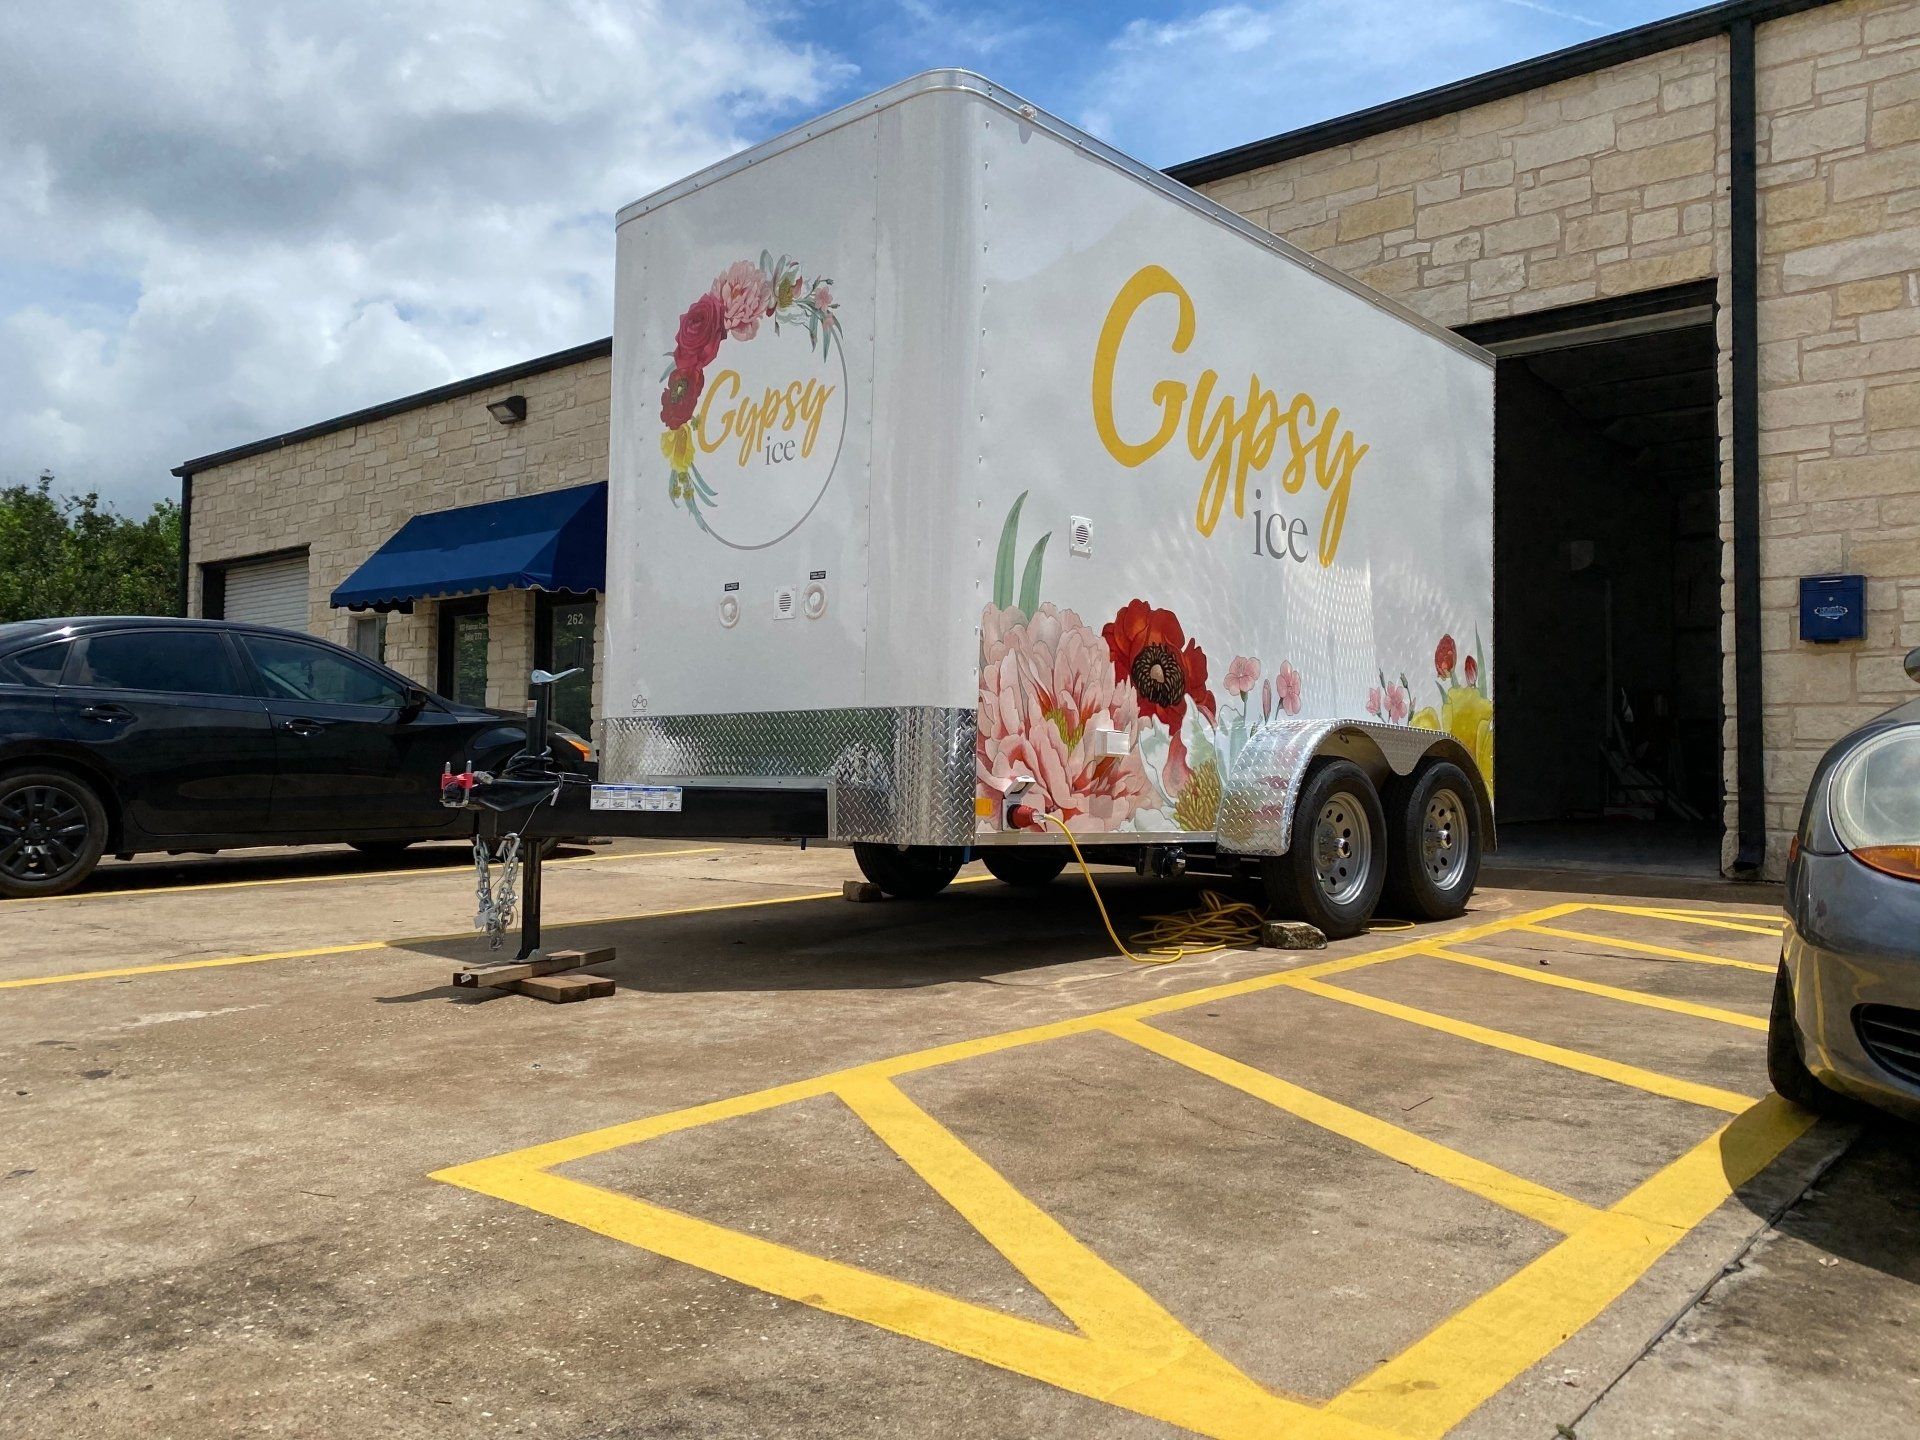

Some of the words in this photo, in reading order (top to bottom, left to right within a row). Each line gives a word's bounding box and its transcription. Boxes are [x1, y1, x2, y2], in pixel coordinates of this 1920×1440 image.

[698, 369, 836, 467] Gypsy
[764, 435, 796, 466] ice
[1092, 265, 1370, 568] Gypsy
[1252, 488, 1309, 563] ice
[566, 613, 584, 626] 262
